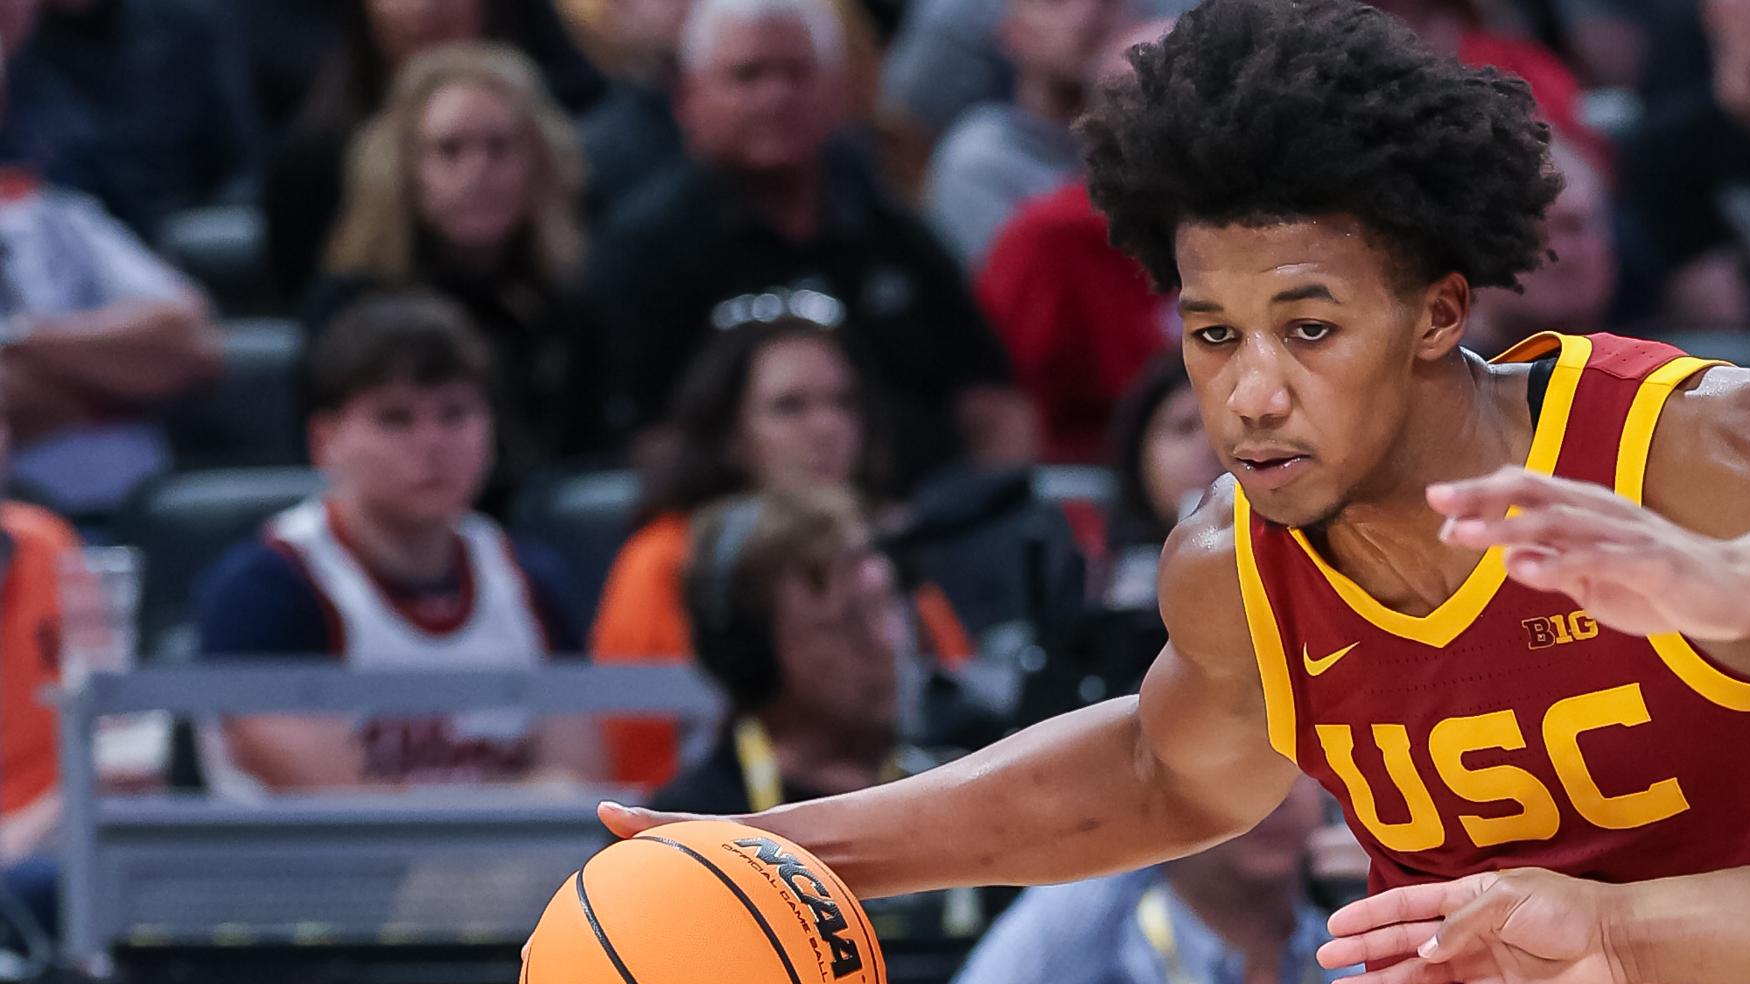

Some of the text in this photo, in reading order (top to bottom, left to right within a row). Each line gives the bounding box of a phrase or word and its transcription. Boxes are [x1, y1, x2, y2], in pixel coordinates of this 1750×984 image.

[1314, 682, 1691, 852] USC
[721, 843, 828, 983] OFFICIAL GAME BALL
[732, 837, 863, 981] NCAA
